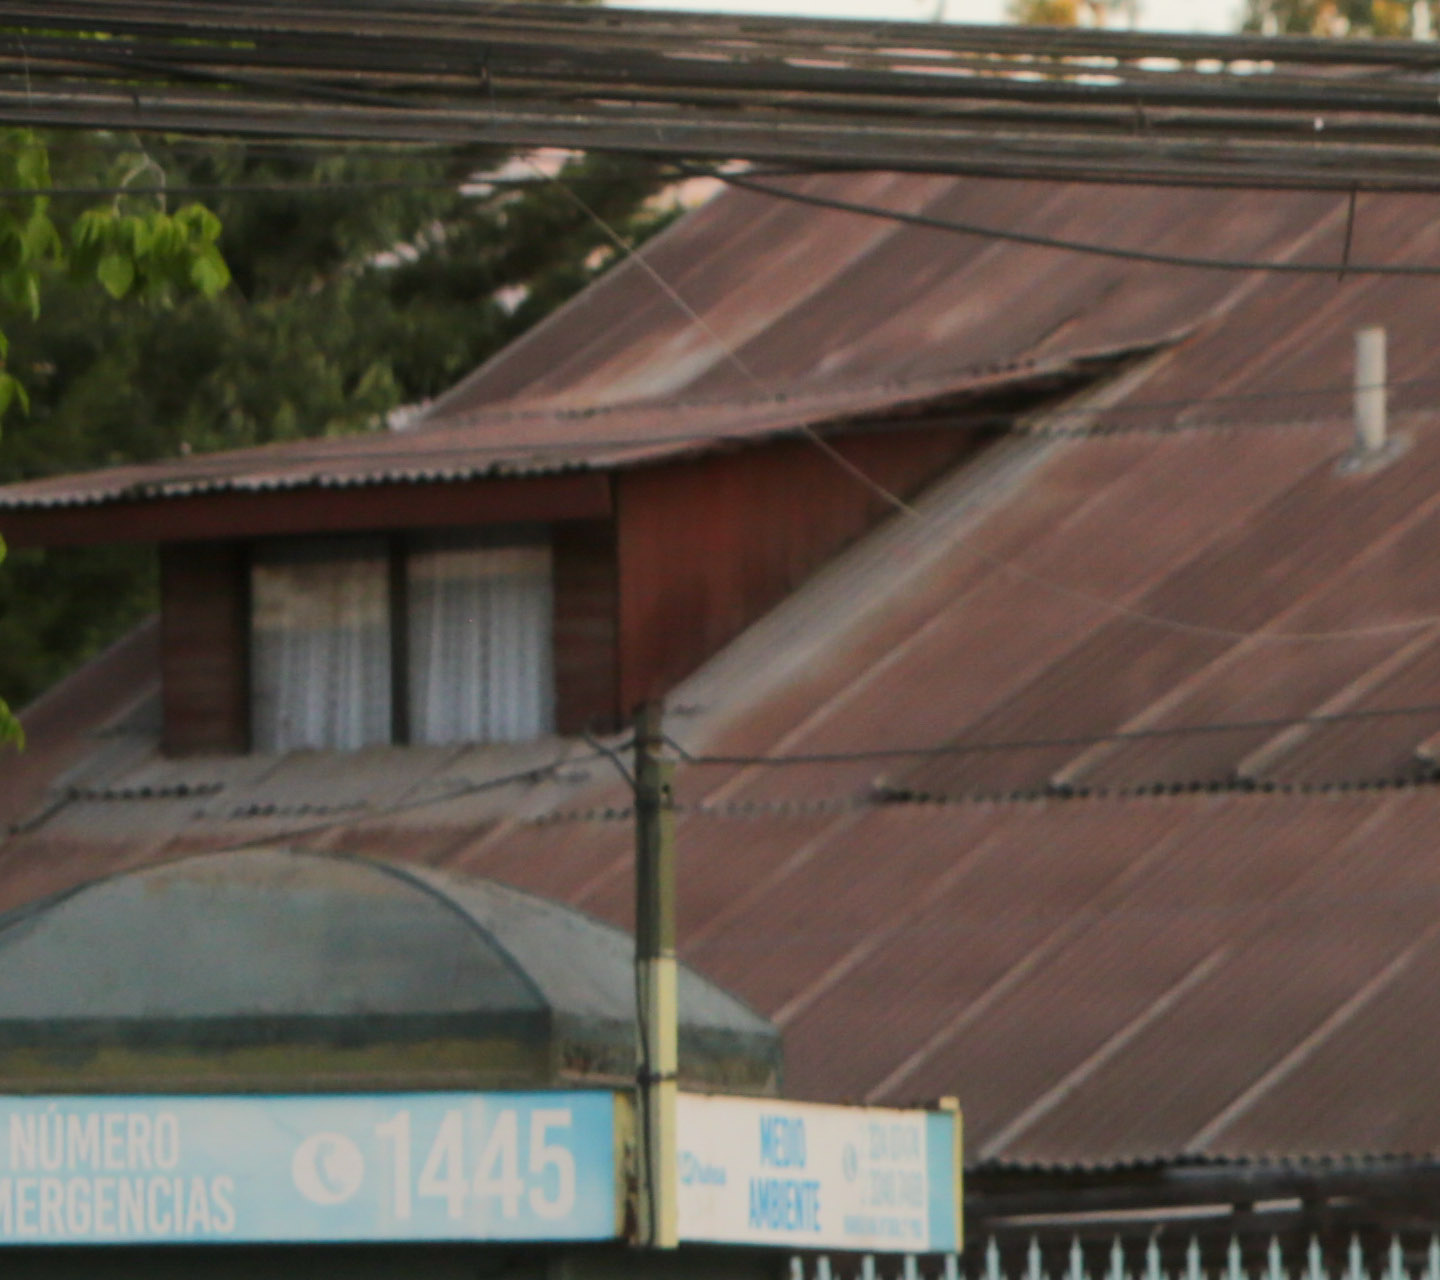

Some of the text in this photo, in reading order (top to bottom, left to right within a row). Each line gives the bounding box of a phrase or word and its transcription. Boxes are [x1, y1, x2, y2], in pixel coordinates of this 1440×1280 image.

[9, 1102, 181, 1171] NÚMERO
[375, 1107, 576, 1222] 1445
[759, 1113, 806, 1168] MEDIO
[748, 1175, 822, 1232] AMBIENTE
